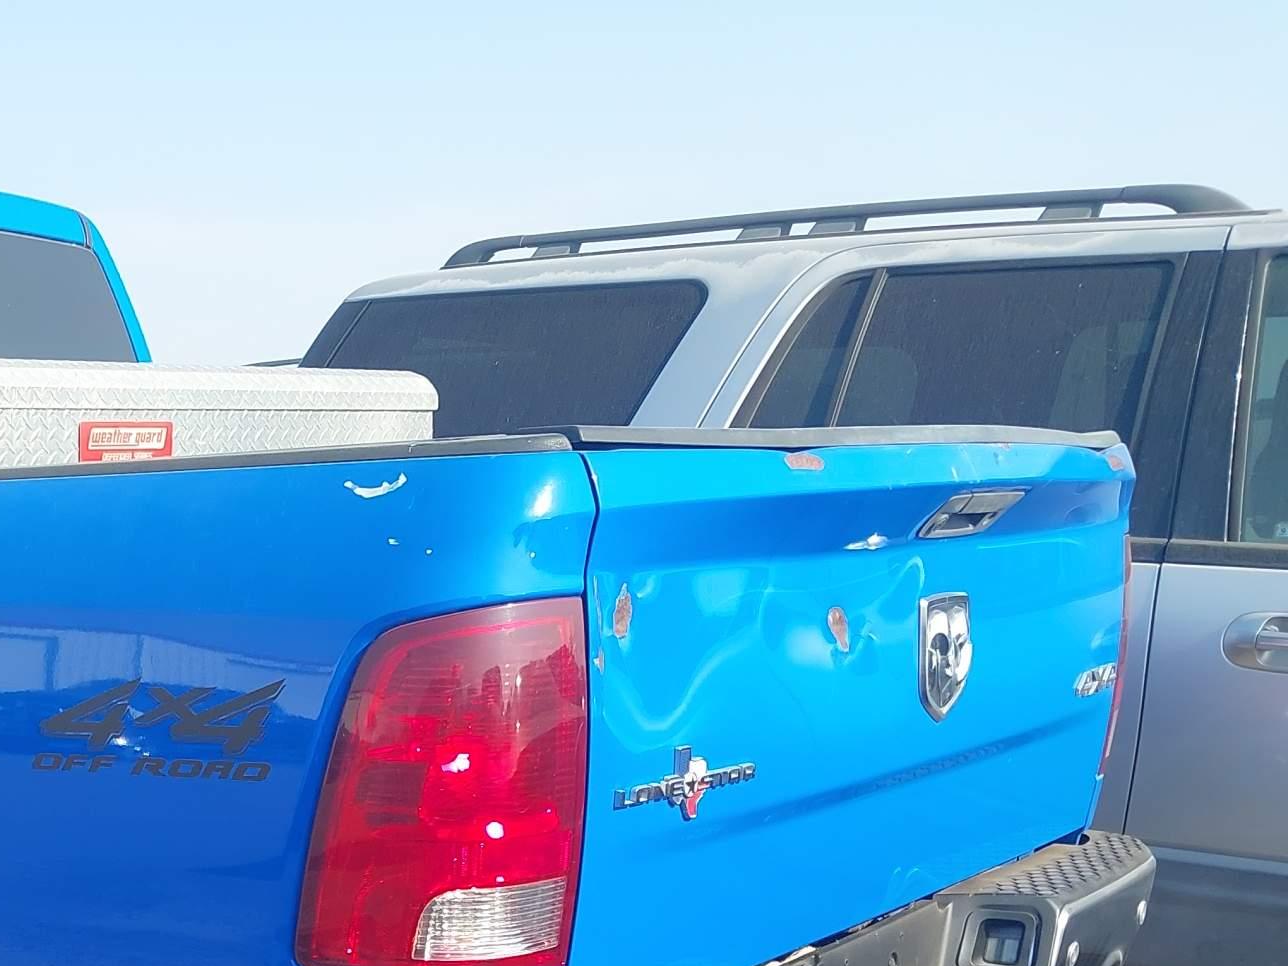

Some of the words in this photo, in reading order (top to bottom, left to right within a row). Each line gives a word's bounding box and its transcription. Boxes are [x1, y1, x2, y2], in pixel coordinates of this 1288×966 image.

[91, 429, 133, 444] weather
[135, 429, 164, 446] guard
[32, 752, 118, 773] OFF
[131, 756, 272, 782] ROAD
[613, 774, 685, 811] LONE
[696, 762, 756, 790] STAR
